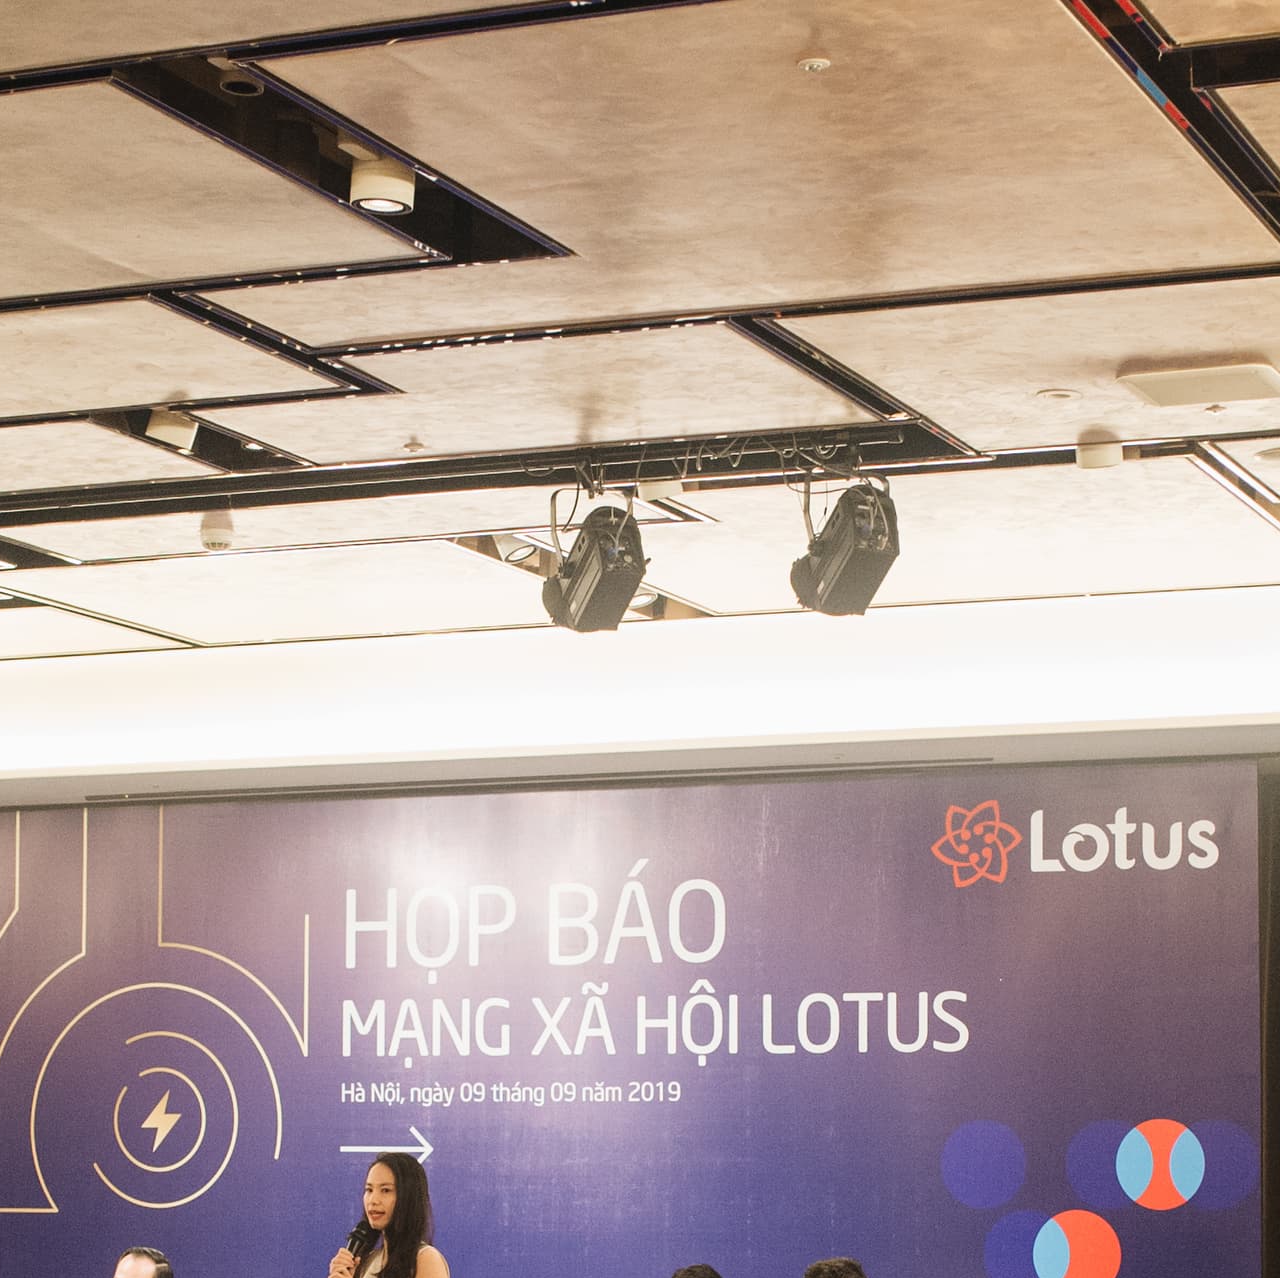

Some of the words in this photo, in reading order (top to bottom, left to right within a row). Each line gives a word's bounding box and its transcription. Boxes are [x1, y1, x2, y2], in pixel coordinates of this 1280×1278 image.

[1030, 807, 1219, 872] Lotus
[346, 885, 516, 984] HỌP
[549, 859, 726, 966] BÁO
[342, 999, 510, 1068] MẠNG
[531, 982, 616, 1056] XÃ
[637, 979, 738, 1067] HỘI
[762, 991, 969, 1054] LOTUS
[341, 1083, 366, 1102] Hà
[371, 1082, 405, 1105] Nội,
[410, 1083, 454, 1106] ngày
[460, 1084, 485, 1102] 09
[491, 1082, 544, 1107] tháng
[550, 1083, 576, 1102] 09
[582, 1082, 622, 1102] năm
[628, 1082, 681, 1102] 2019
